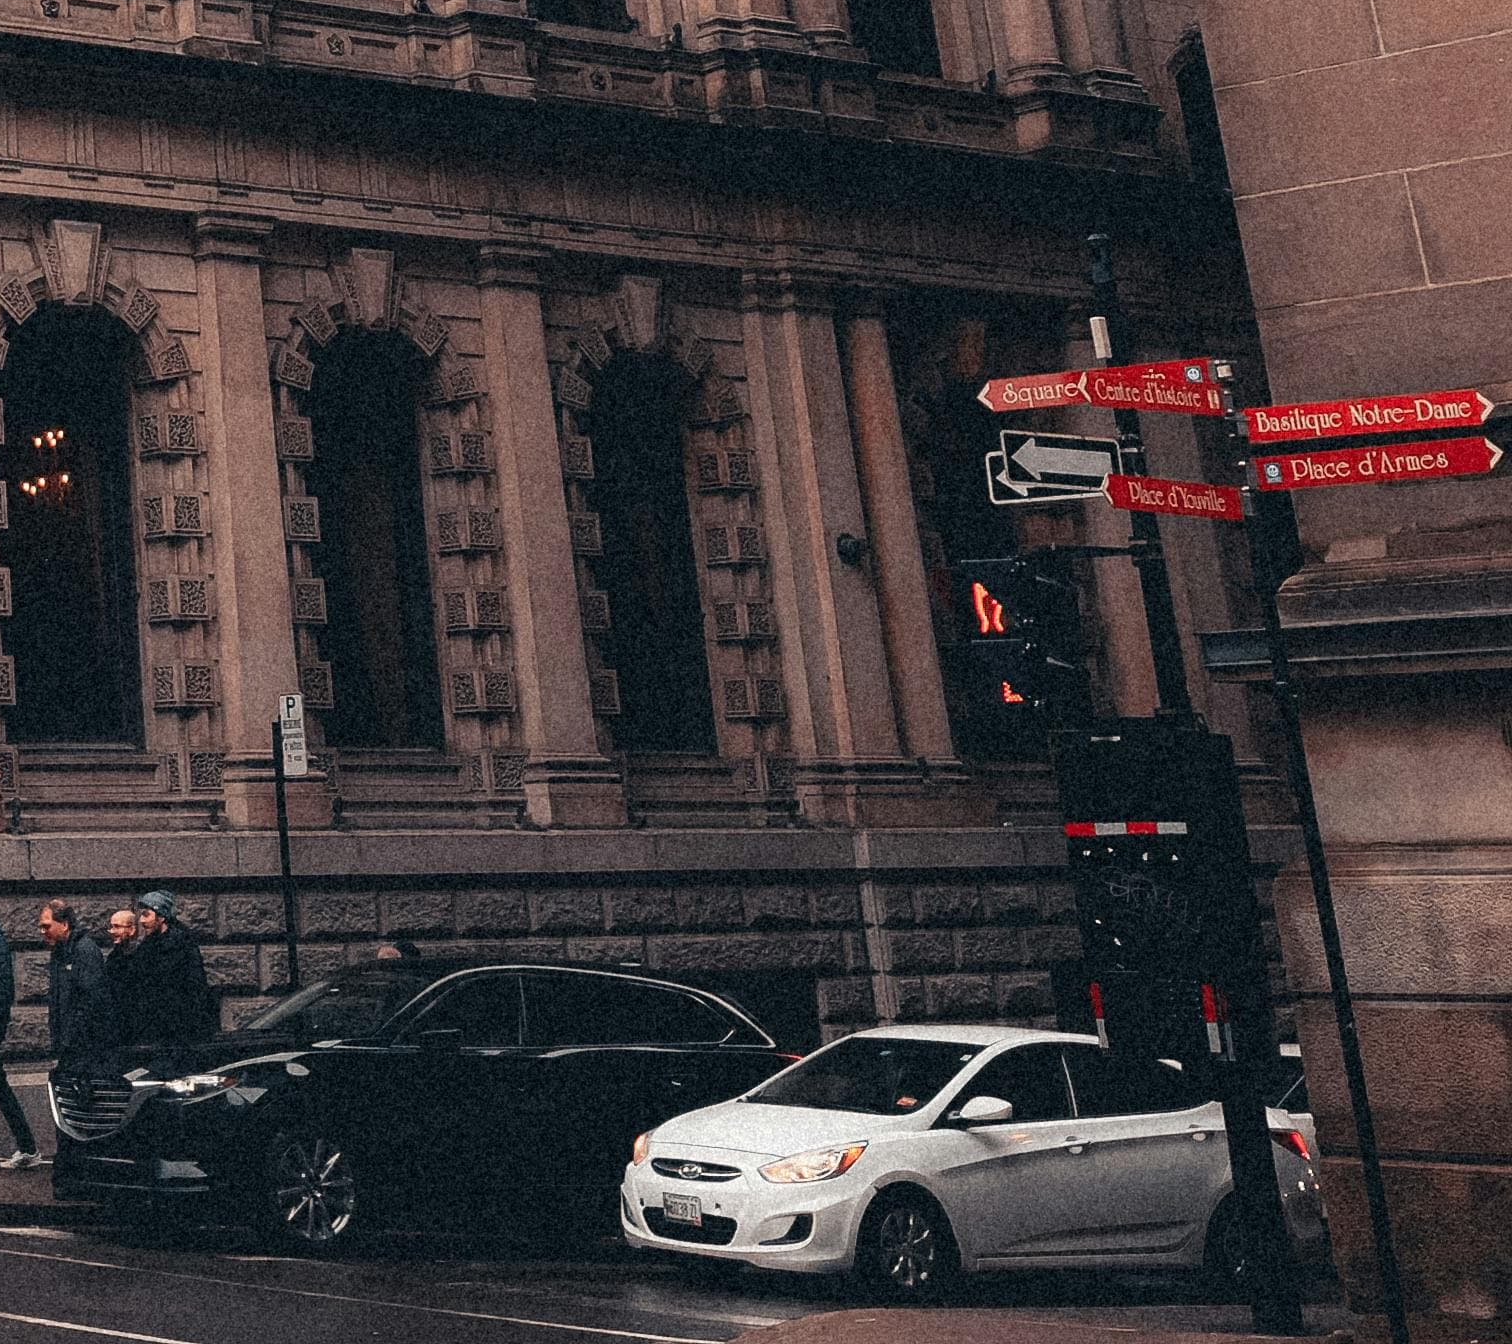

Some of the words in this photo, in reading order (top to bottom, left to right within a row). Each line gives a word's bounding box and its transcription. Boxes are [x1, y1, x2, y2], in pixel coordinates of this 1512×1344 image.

[1002, 382, 1079, 408] Square
[1095, 378, 1141, 402] Centre
[1144, 381, 1202, 408] d'histoire
[1255, 408, 1343, 436] Basilique
[1349, 399, 1472, 428] Notre-Dame
[1290, 458, 1351, 482] Place
[1358, 450, 1449, 476] d'Armes
[1127, 481, 1165, 506] Place
[1168, 485, 1226, 512] d'Youville
[286, 696, 296, 718] P
